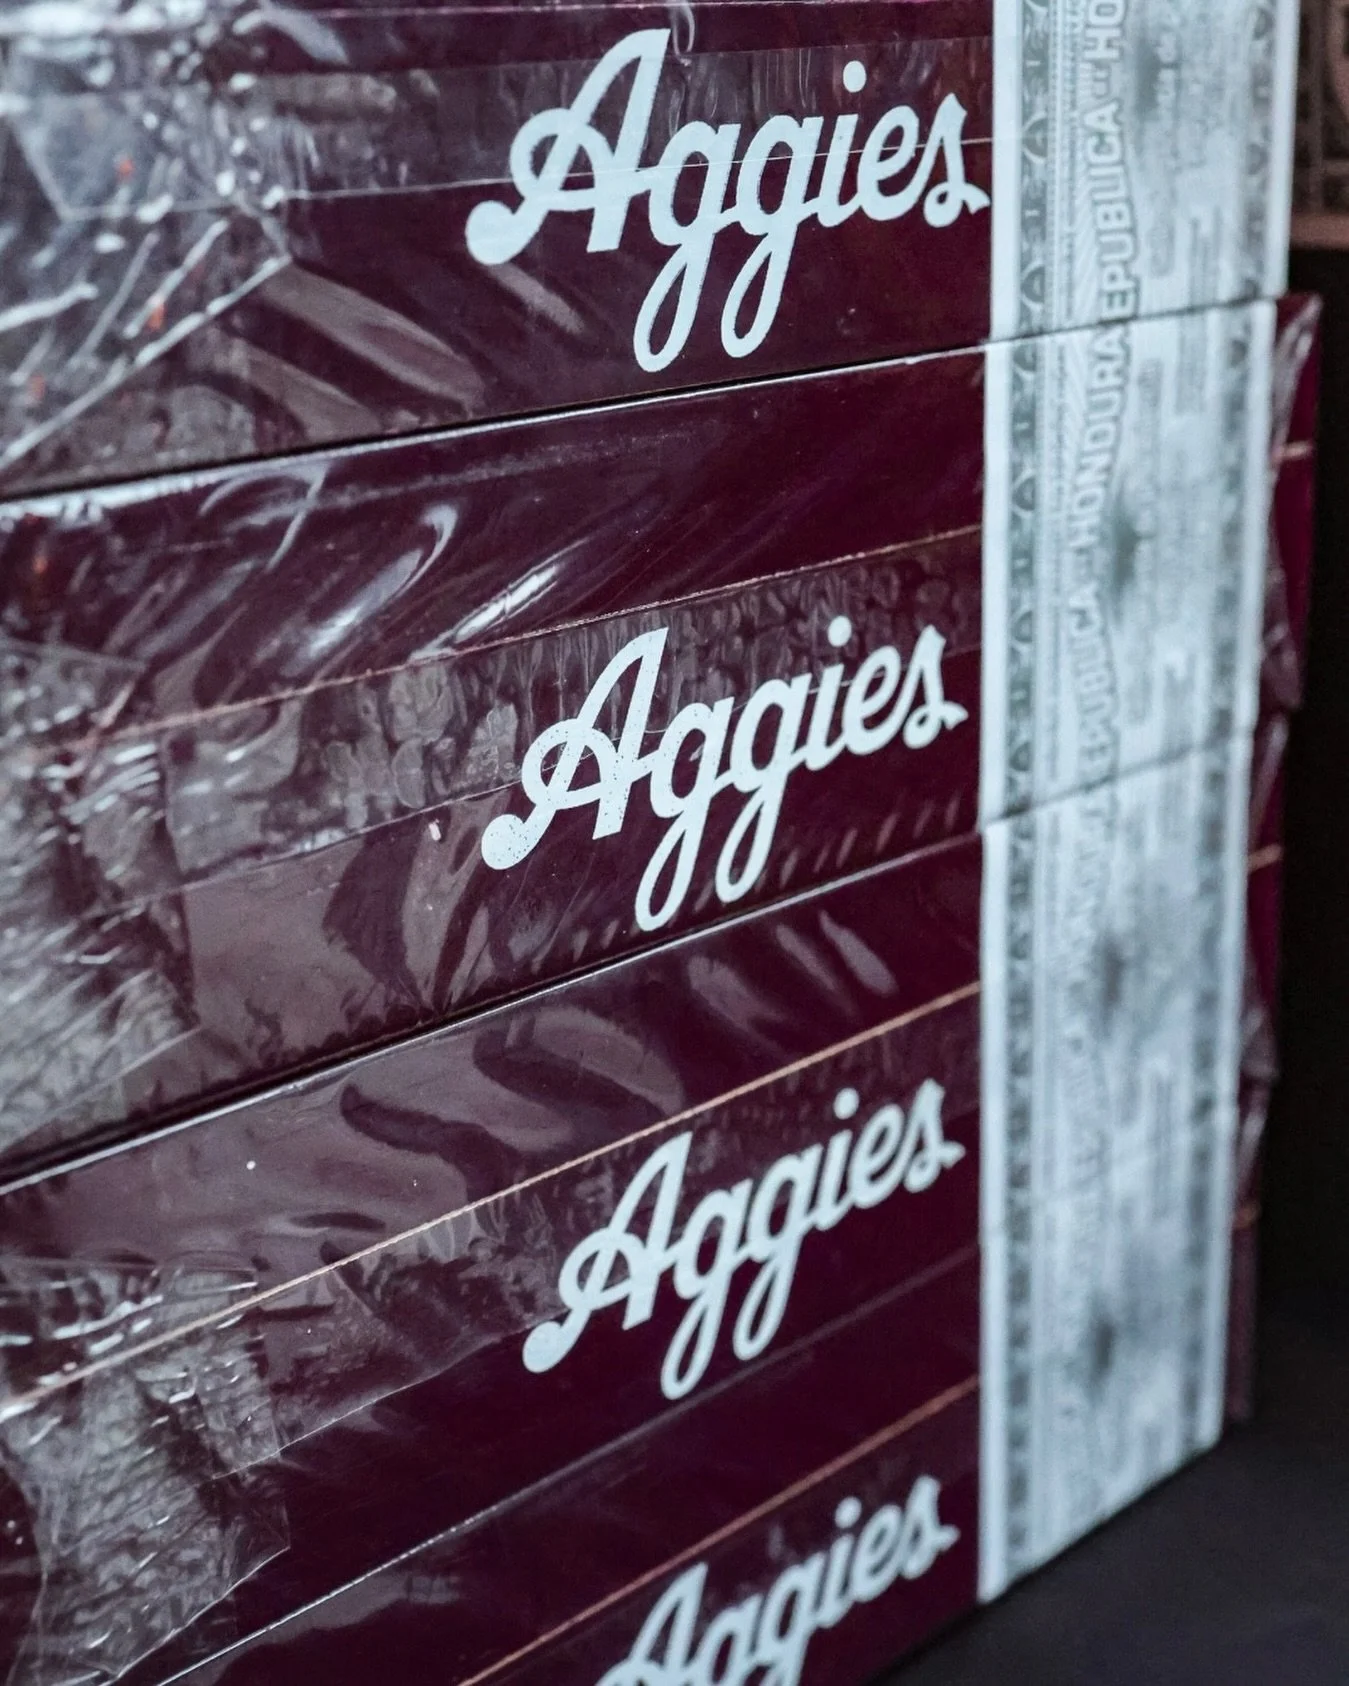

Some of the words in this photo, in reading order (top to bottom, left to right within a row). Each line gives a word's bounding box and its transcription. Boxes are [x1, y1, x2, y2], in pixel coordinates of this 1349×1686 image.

[1083, 0, 1124, 61] HO
[464, 28, 990, 373] Aggies
[1083, 101, 1139, 321] EPUBLICA
[1067, 323, 1130, 551] HONDURA
[481, 615, 968, 932] Aggies
[1066, 583, 1119, 775] EPUBLICA
[522, 1078, 966, 1400] Aggies
